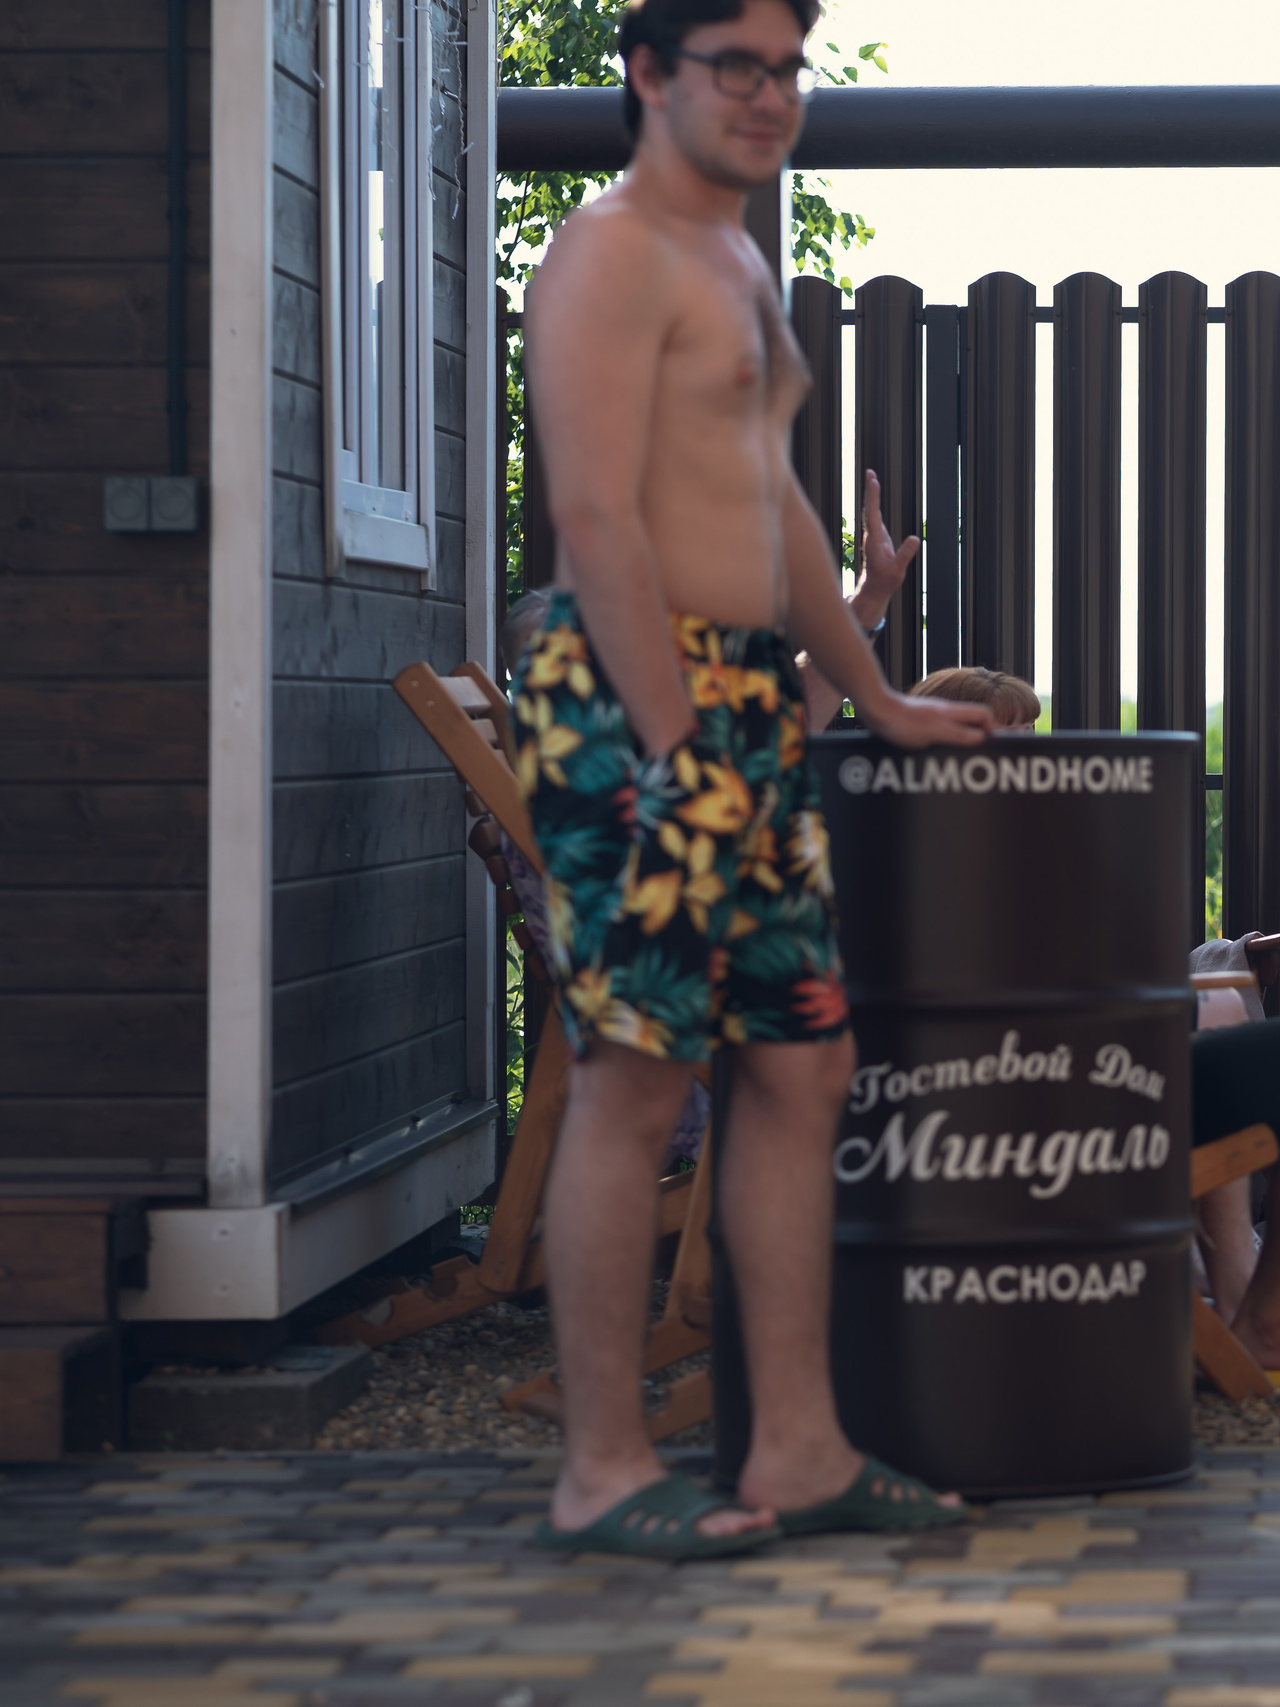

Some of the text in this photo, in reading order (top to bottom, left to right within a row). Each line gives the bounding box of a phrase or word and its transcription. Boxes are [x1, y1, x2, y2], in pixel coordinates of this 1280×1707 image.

[838, 754, 1153, 795] @ALMONDHOME
[848, 1029, 1167, 1114] Гостевой Дом
[833, 1110, 1169, 1200] Миндаль
[903, 1260, 1147, 1306] КРАСНОДАР
